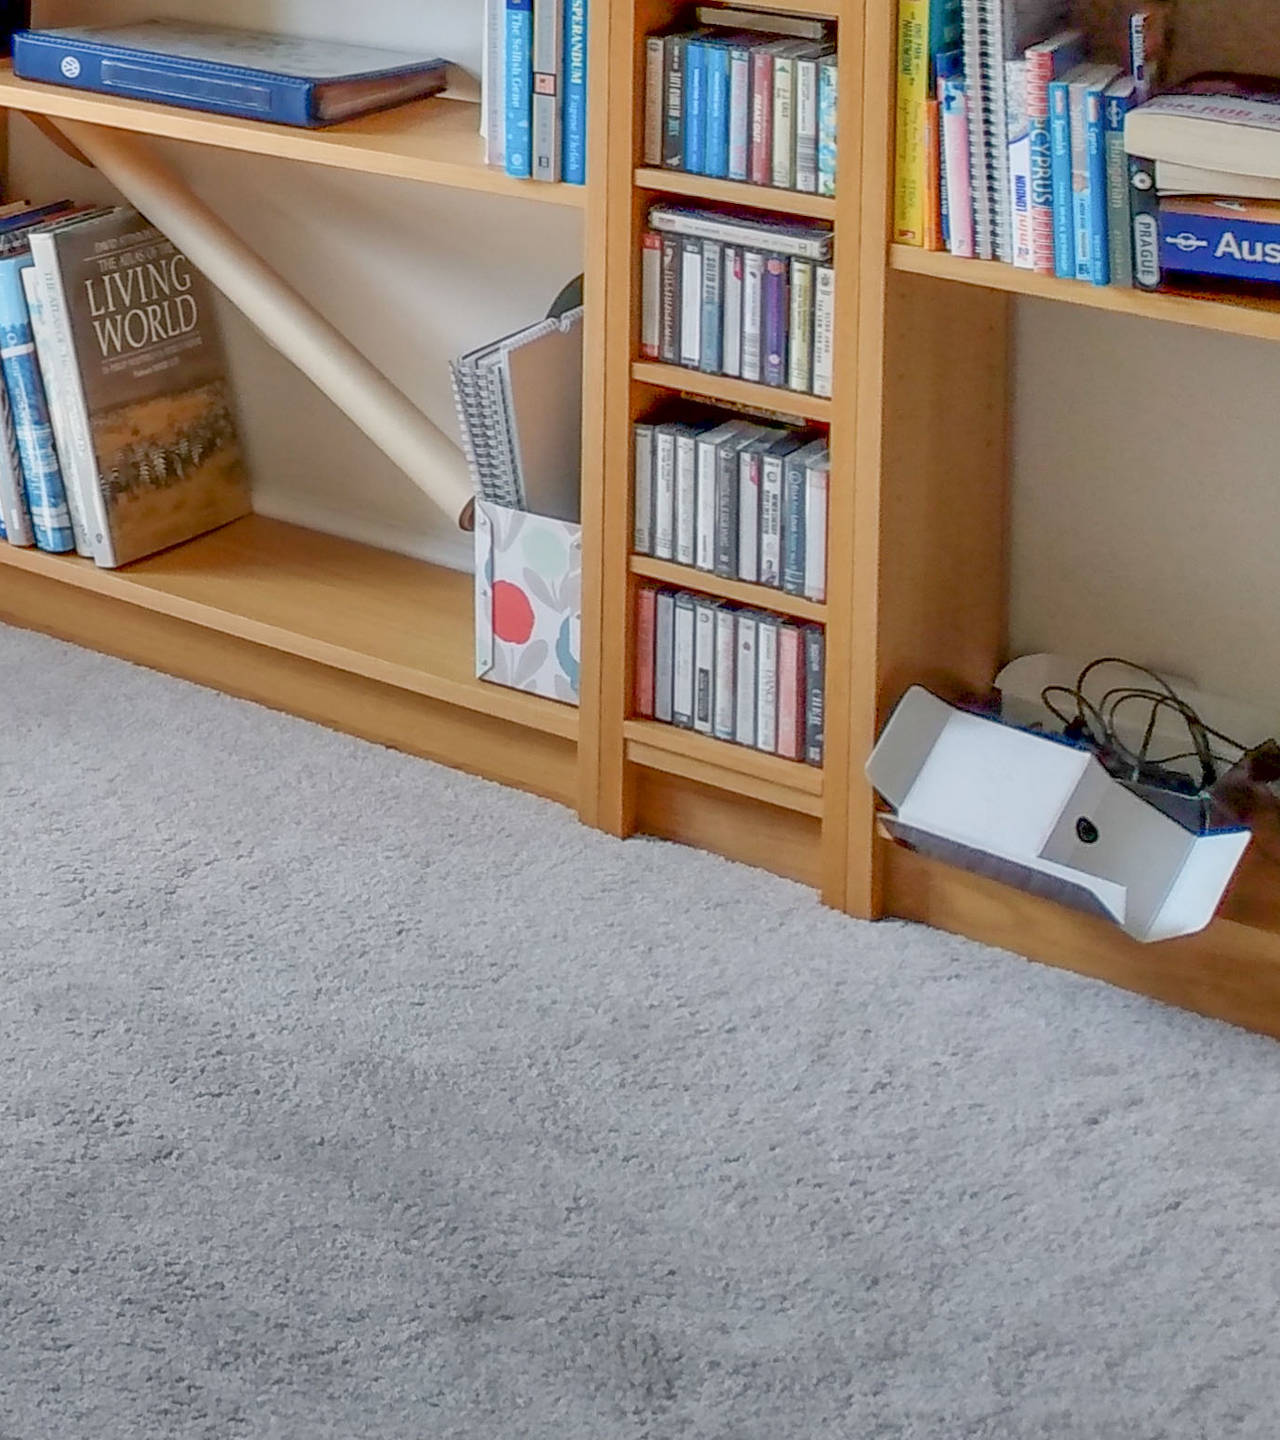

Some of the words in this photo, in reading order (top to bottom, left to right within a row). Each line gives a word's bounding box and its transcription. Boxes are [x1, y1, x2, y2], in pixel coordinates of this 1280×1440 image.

[512, 13, 522, 35] The
[512, 38, 523, 75] Selfish
[1031, 129, 1053, 203] CYPRUS
[1139, 221, 1154, 277] PRAGUE
[85, 254, 192, 317] LIVING
[92, 294, 198, 357] WORLD
